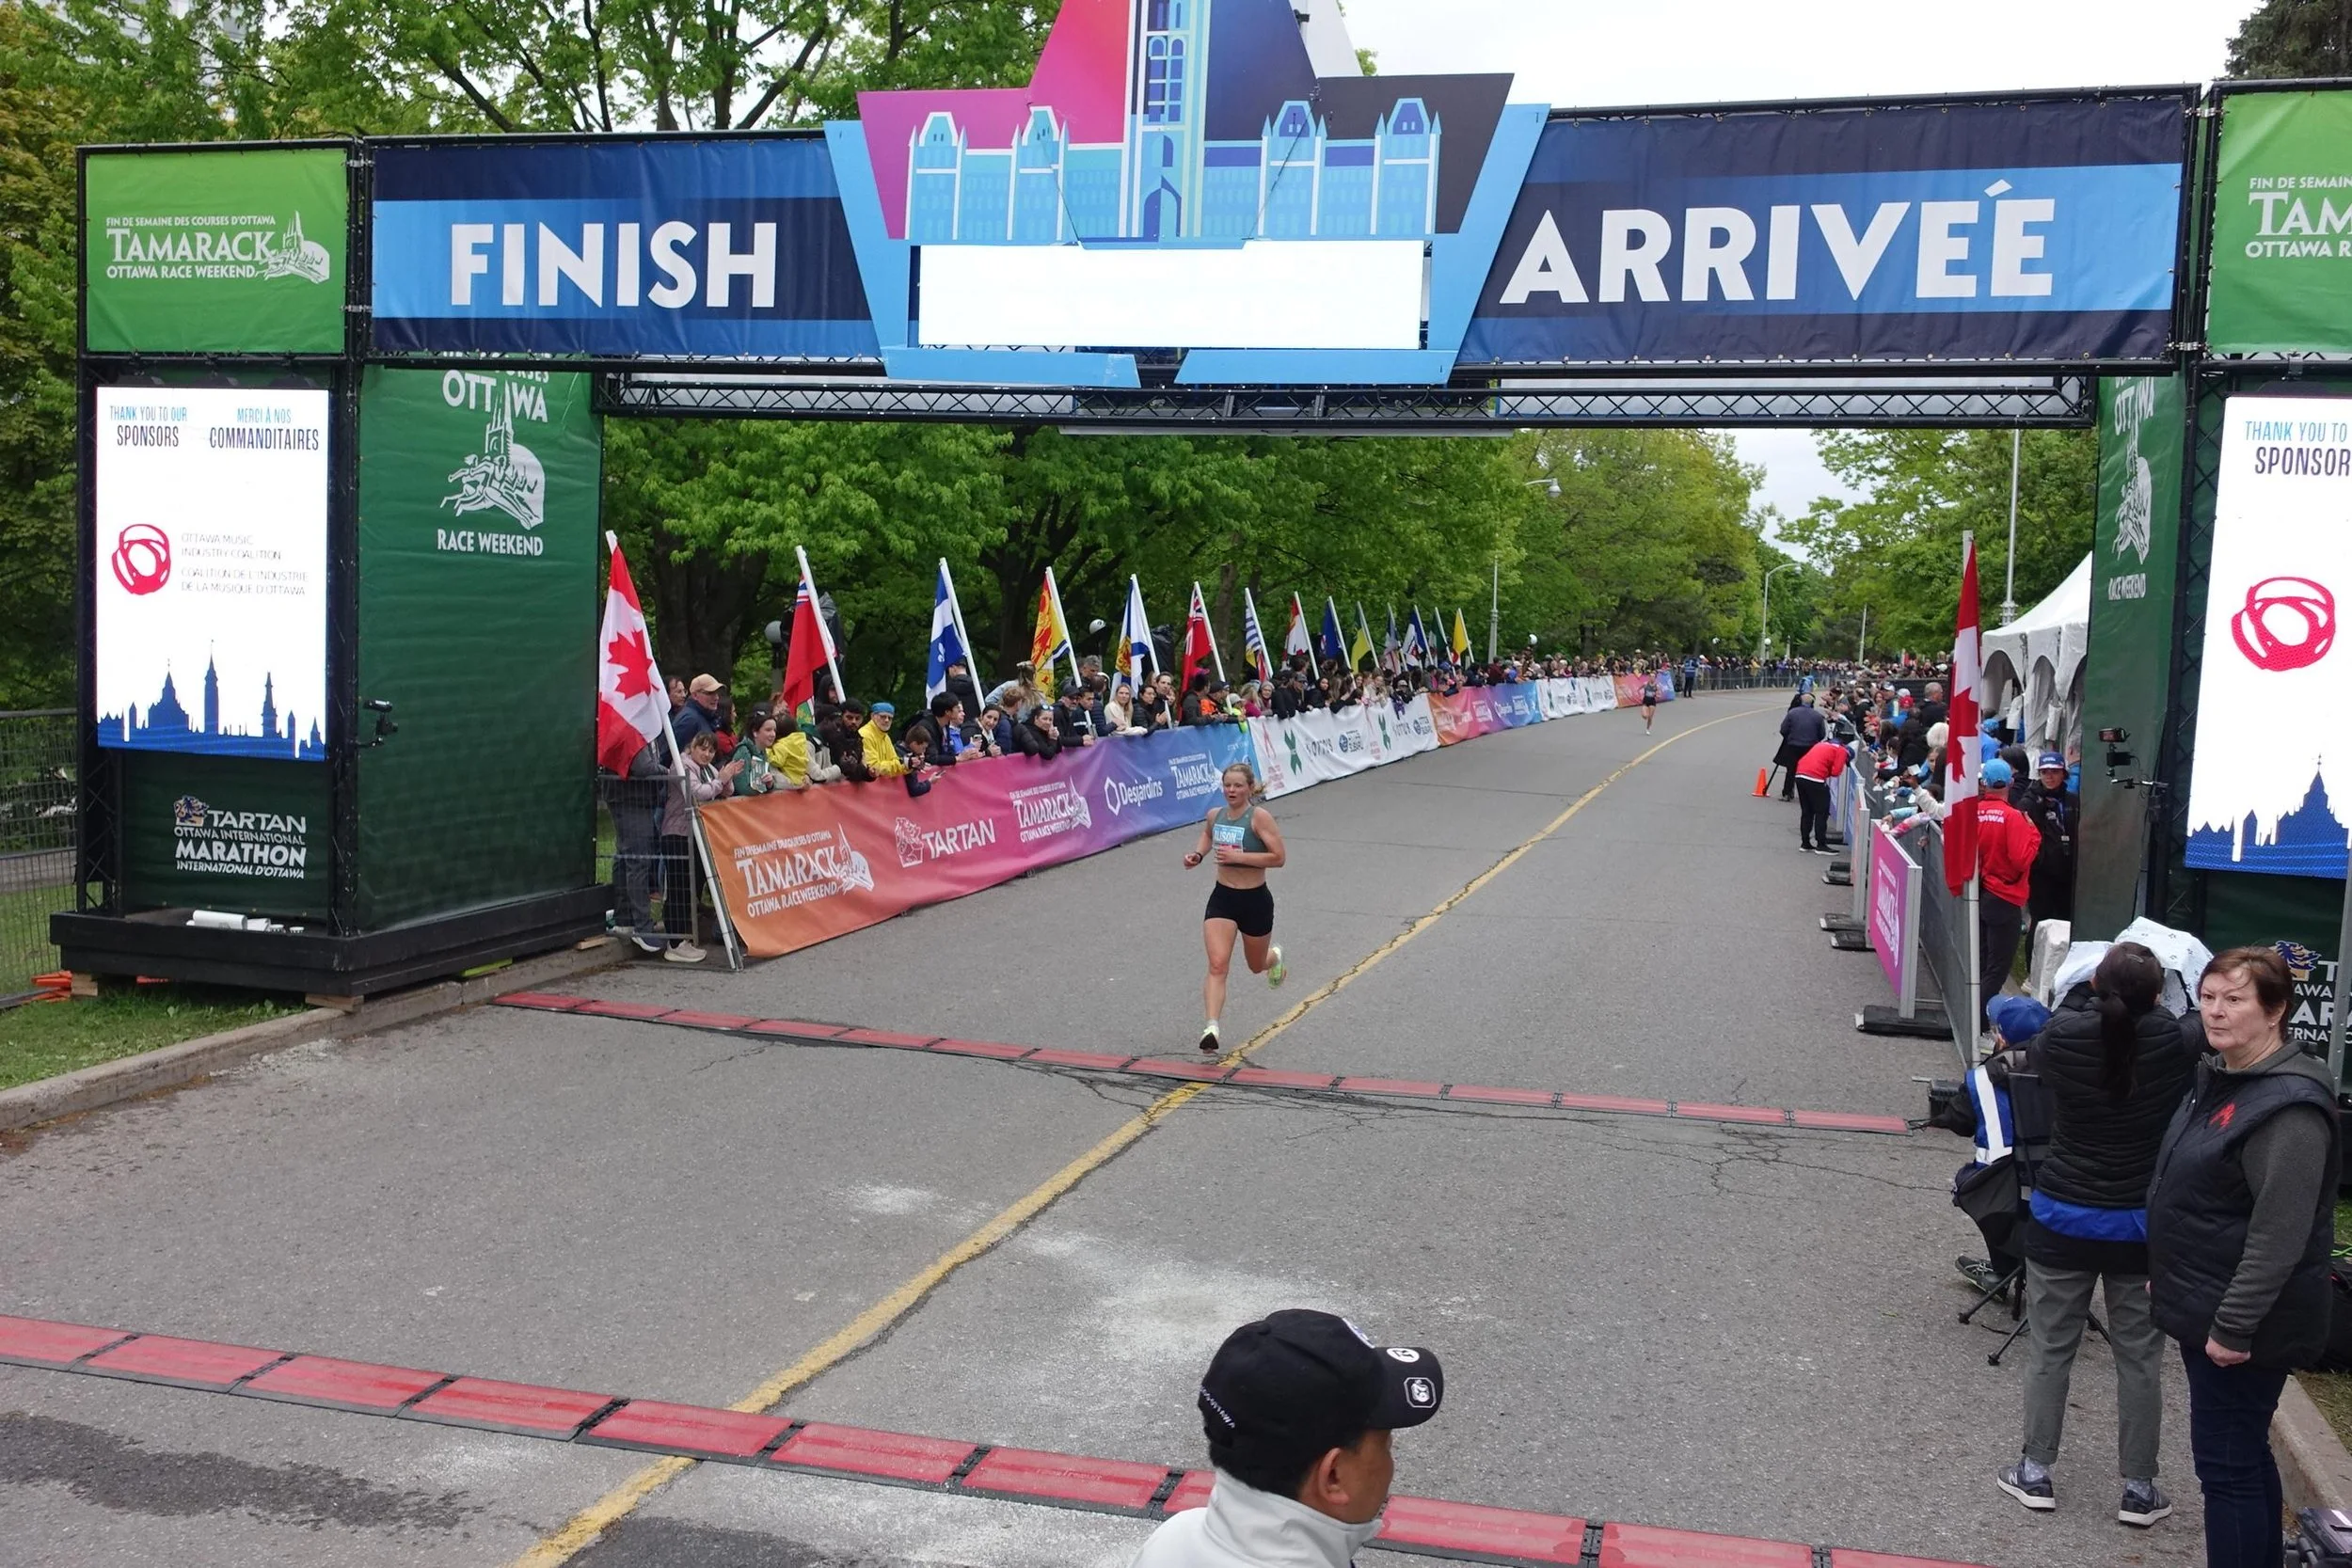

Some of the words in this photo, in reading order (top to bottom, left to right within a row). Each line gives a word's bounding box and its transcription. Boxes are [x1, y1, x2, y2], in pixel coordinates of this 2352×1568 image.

[2249, 177, 2274, 189] FIN
[2278, 177, 2296, 189] DE
[106, 216, 120, 227] FIN
[122, 216, 134, 227] DE
[135, 216, 172, 227] SEMAINE
[175, 216, 189, 226] DES
[191, 215, 230, 226] COURSES
[230, 214, 276, 226] D'OTTAWA
[106, 227, 276, 262] TAMARACK
[1499, 179, 2056, 304] ARRIVEÉ
[2245, 240, 2333, 259] OTTAWA
[106, 264, 159, 279] OTTAWA
[161, 264, 192, 278] RACE
[195, 264, 256, 278] WEEKEND
[451, 220, 777, 309] FINISH
[109, 405, 137, 421] THANK
[140, 405, 156, 421] YOU
[158, 406, 168, 422] TO
[170, 406, 187, 422] OUR
[237, 407, 262, 423] MERCI
[274, 408, 292, 423] NOS
[117, 424, 179, 448] SPONSORS
[210, 427, 319, 451] COMMANDITAIRES
[2245, 420, 2293, 441] THANK
[2299, 421, 2327, 442] YOU
[2331, 422, 2348, 443] TO
[182, 532, 220, 544] OTTAWA
[222, 534, 254, 545] MUSIC
[437, 529, 475, 552] RACE
[478, 531, 544, 556] WEEKEND
[1119, 776, 1163, 807] Desjardins
[206, 809, 307, 834] TARTAN
[1013, 793, 1073, 829] TAMARACK
[174, 826, 219, 840] OTTAWA
[220, 829, 306, 846] INTERNATIONAL
[922, 818, 996, 860] TARTAN
[175, 838, 307, 867] MARATHON
[177, 860, 254, 876] INTERNATIONAL
[255, 864, 305, 879] D'OTTAWA
[736, 846, 840, 898] TAMARACK
[747, 898, 781, 918] OTTAWA
[782, 891, 801, 909] RACE
[800, 881, 837, 904] WEEKEND
